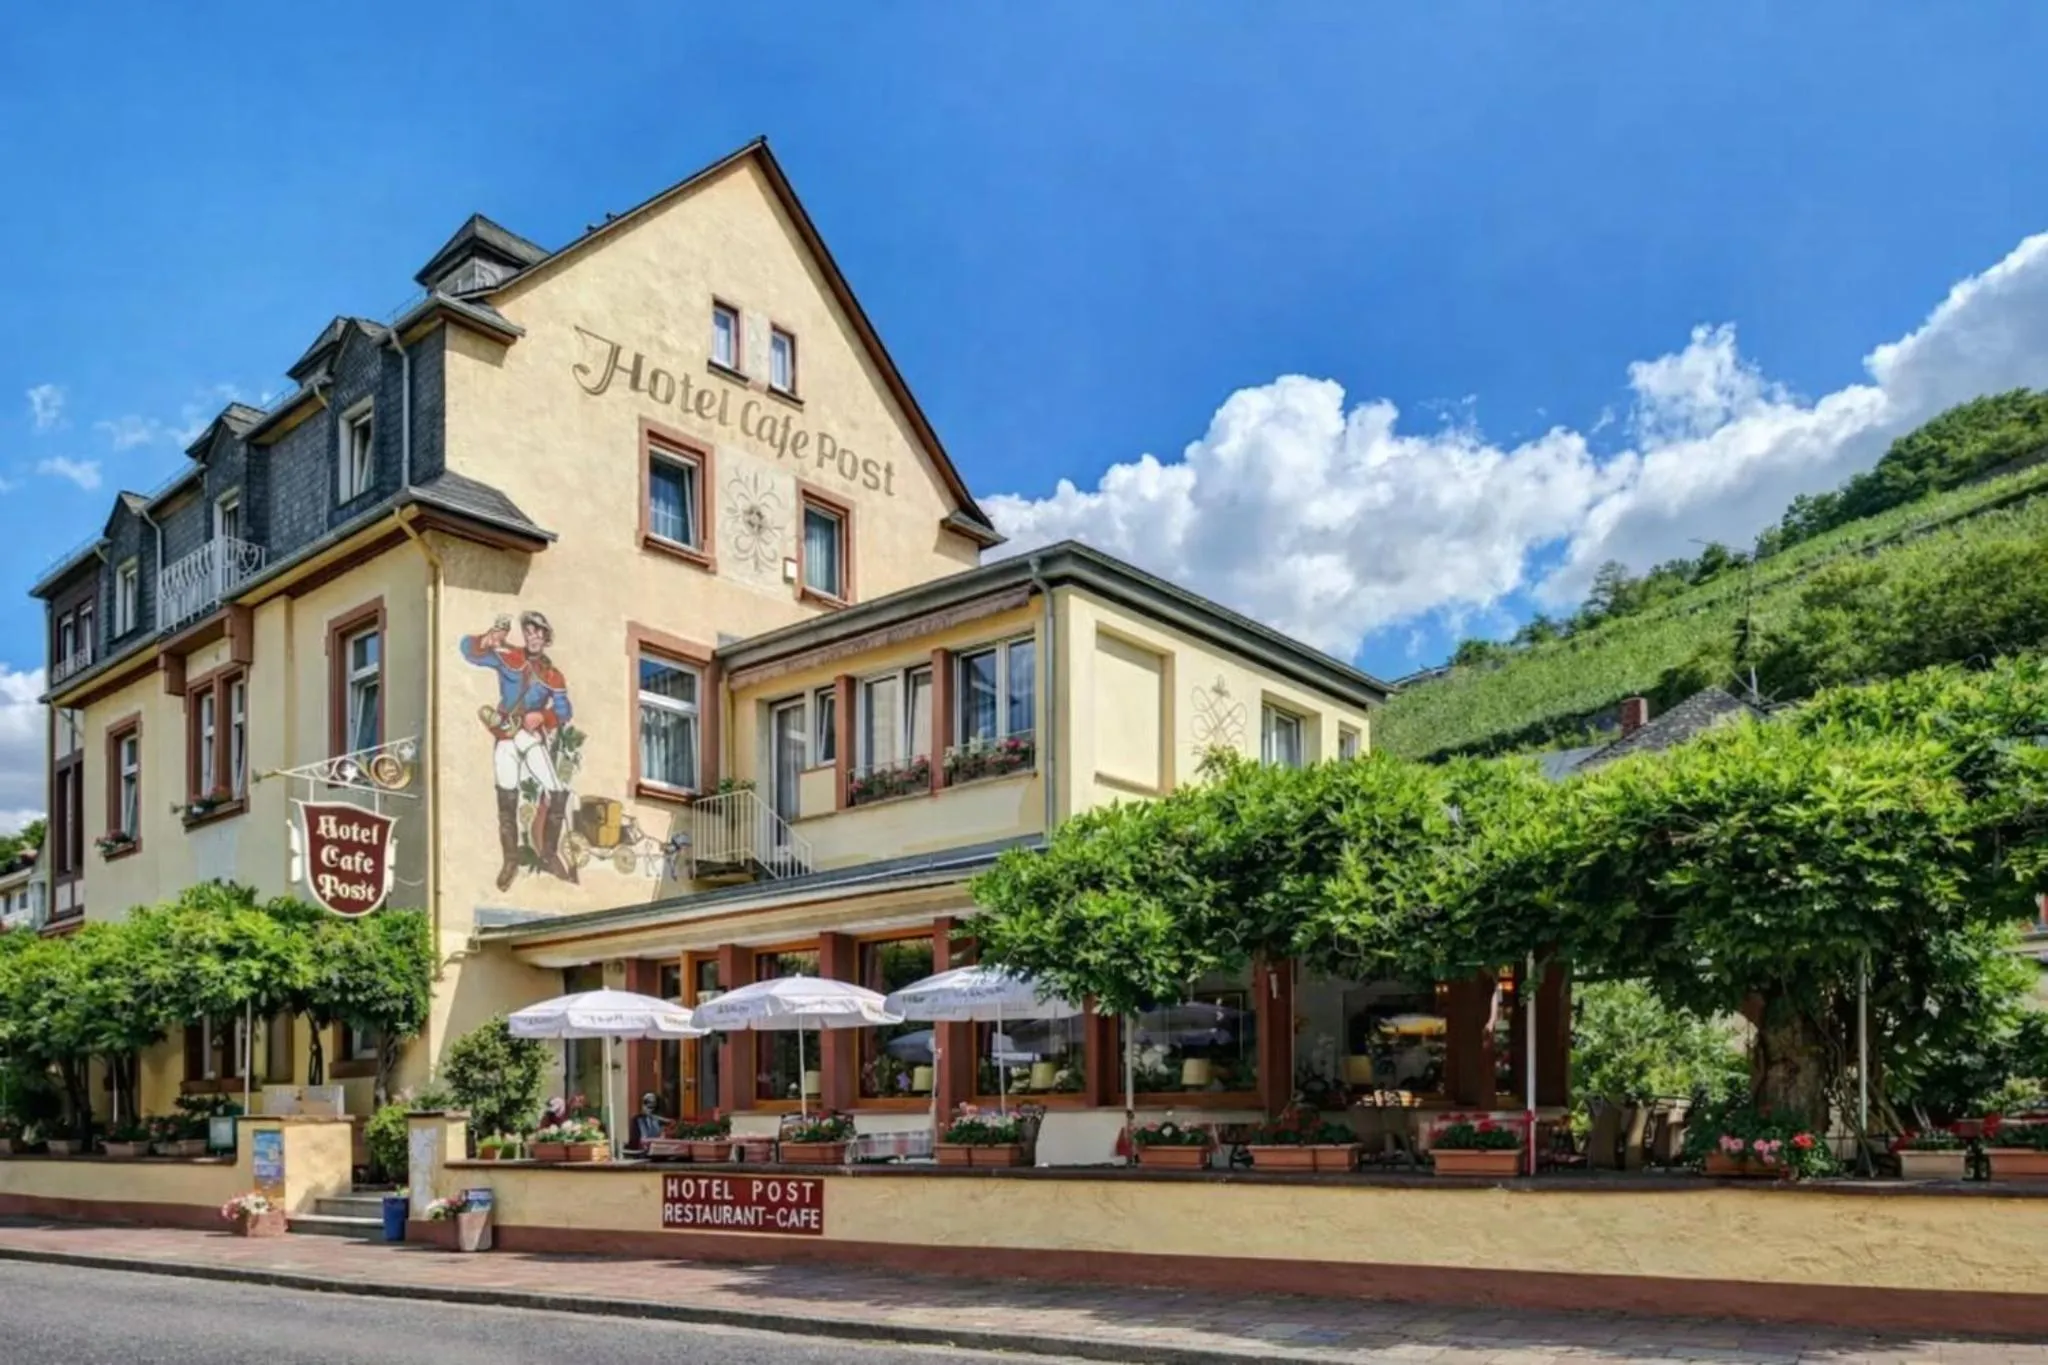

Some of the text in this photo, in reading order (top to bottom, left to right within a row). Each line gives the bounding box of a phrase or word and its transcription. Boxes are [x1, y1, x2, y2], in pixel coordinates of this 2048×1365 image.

[572, 326, 730, 427] Hotel
[741, 399, 808, 460] Cafe
[316, 815, 380, 845] Hotel
[320, 844, 375, 874] Cafe
[317, 874, 376, 901] Post
[666, 1178, 815, 1203] HOTEL POST
[664, 1202, 820, 1229] RESTAURANT-CAFE
